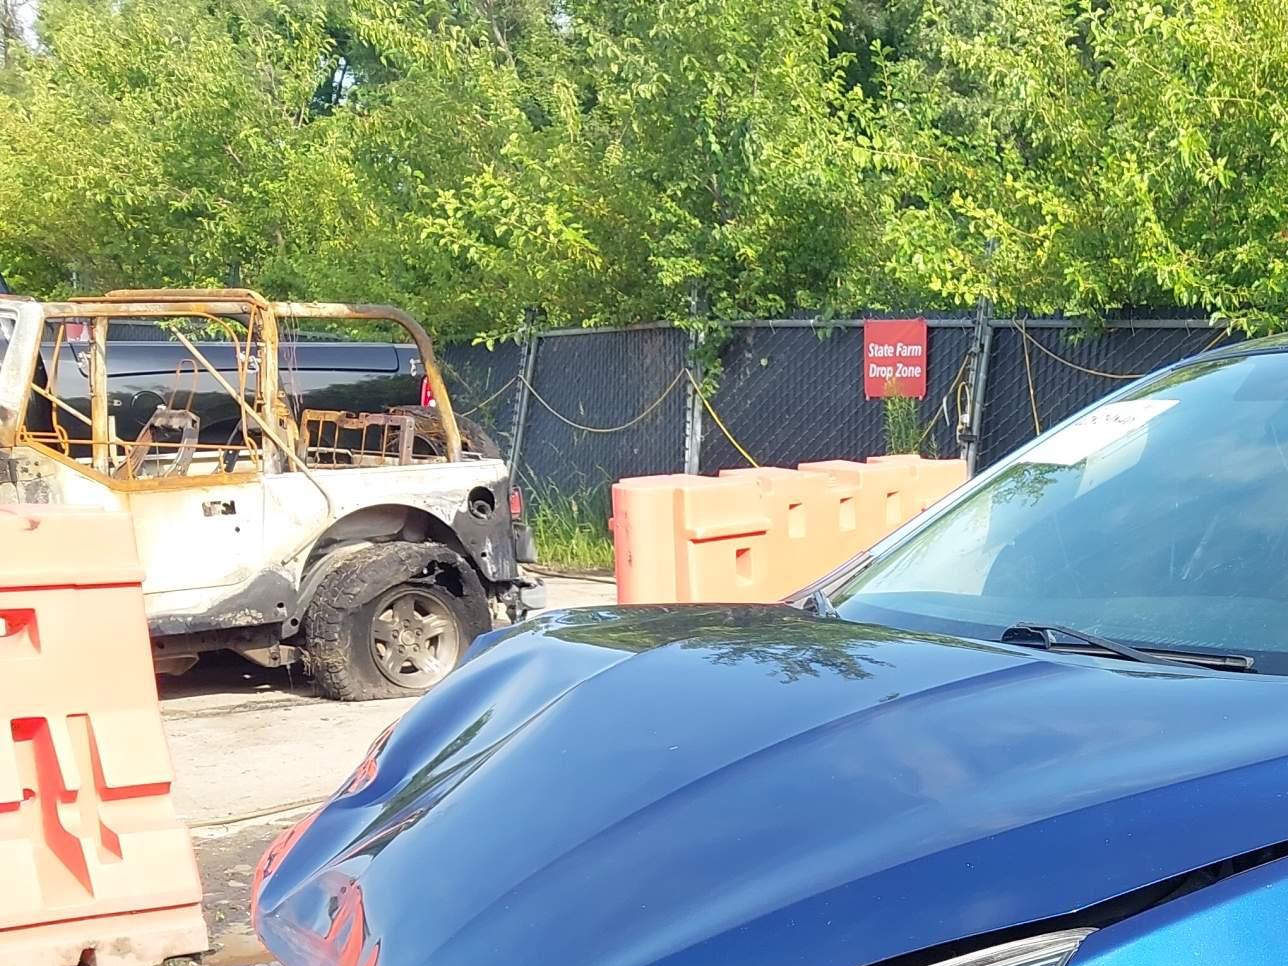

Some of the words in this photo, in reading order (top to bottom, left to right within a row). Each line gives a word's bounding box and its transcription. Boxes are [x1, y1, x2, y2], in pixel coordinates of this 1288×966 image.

[868, 343, 894, 357] State
[896, 342, 922, 357] Farm
[869, 363, 893, 379] Drop
[895, 363, 921, 378] Zone
